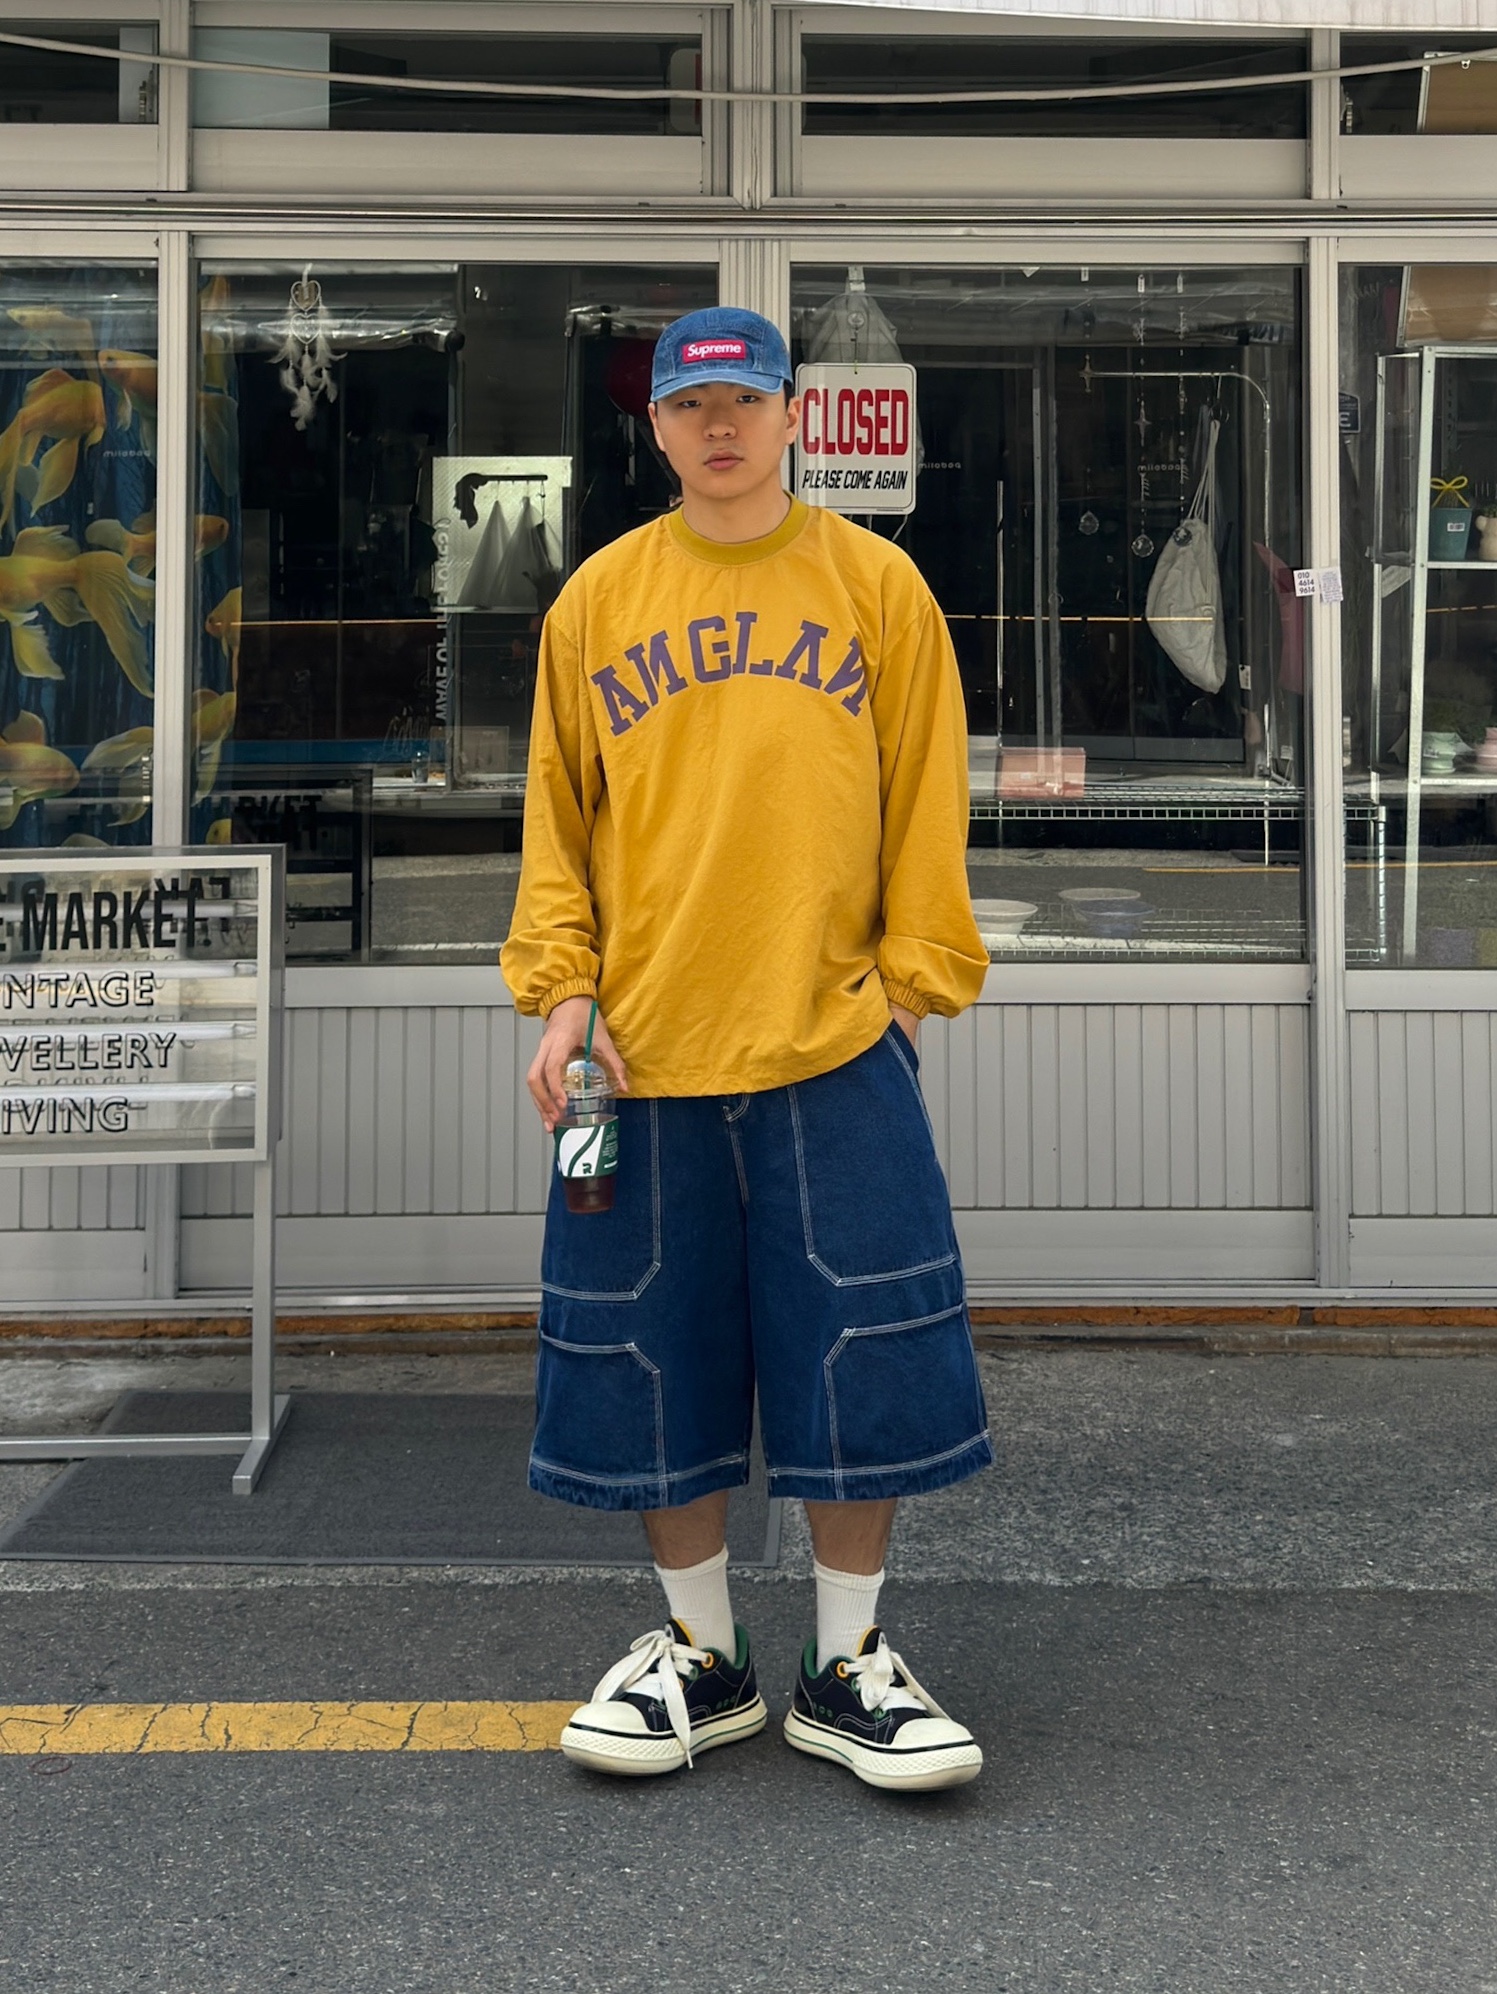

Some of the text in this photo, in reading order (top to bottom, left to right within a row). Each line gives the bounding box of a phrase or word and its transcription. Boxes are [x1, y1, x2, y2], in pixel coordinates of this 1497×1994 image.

[687, 344, 742, 358] Supreme
[802, 388, 909, 456] CLOSED
[802, 470, 909, 490] PLEASE COME AGAIN
[1297, 571, 1310, 579] 010
[3, 970, 154, 1009] NTAGE
[2, 1096, 129, 1135] IVING
